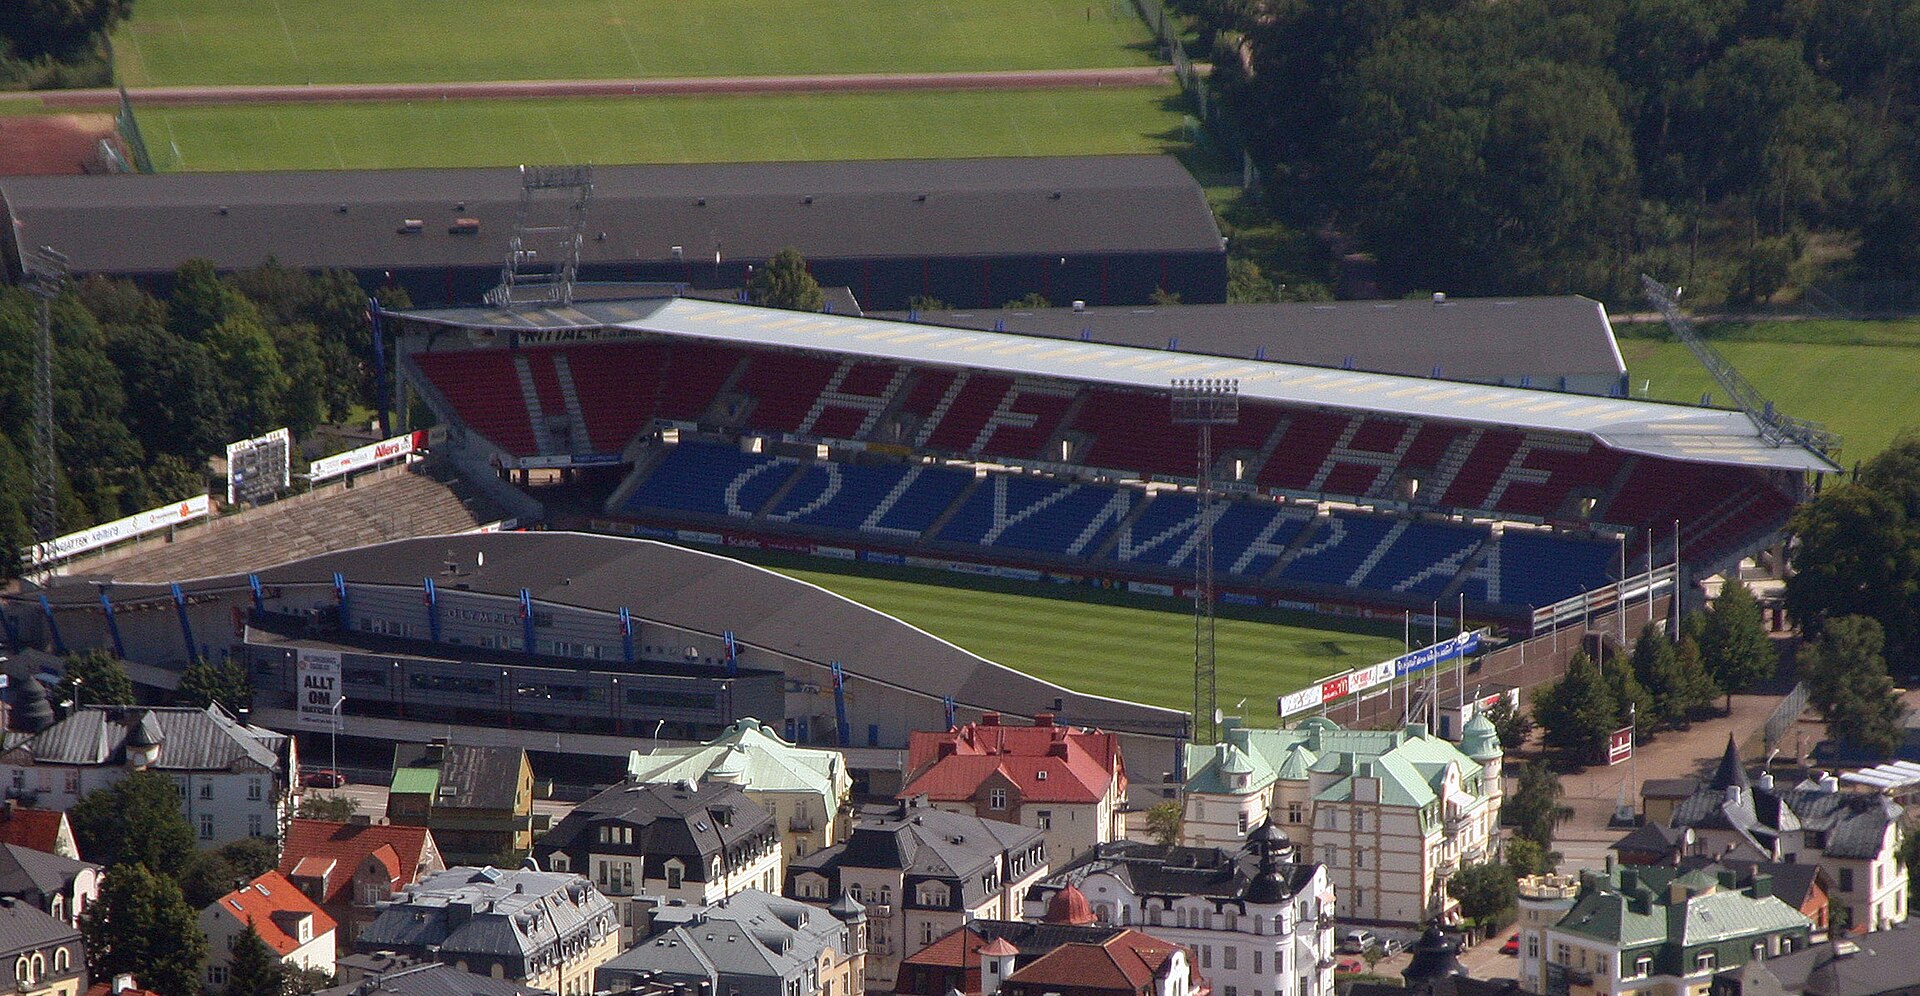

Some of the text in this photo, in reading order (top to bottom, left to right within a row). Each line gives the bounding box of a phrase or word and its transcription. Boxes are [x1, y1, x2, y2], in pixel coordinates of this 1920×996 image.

[793, 357, 1083, 456] HIF
[1305, 414, 1593, 511] HIF
[724, 455, 1503, 603] OLYMPIA
[303, 675, 336, 691] ALLT
[308, 690, 331, 705] OM
